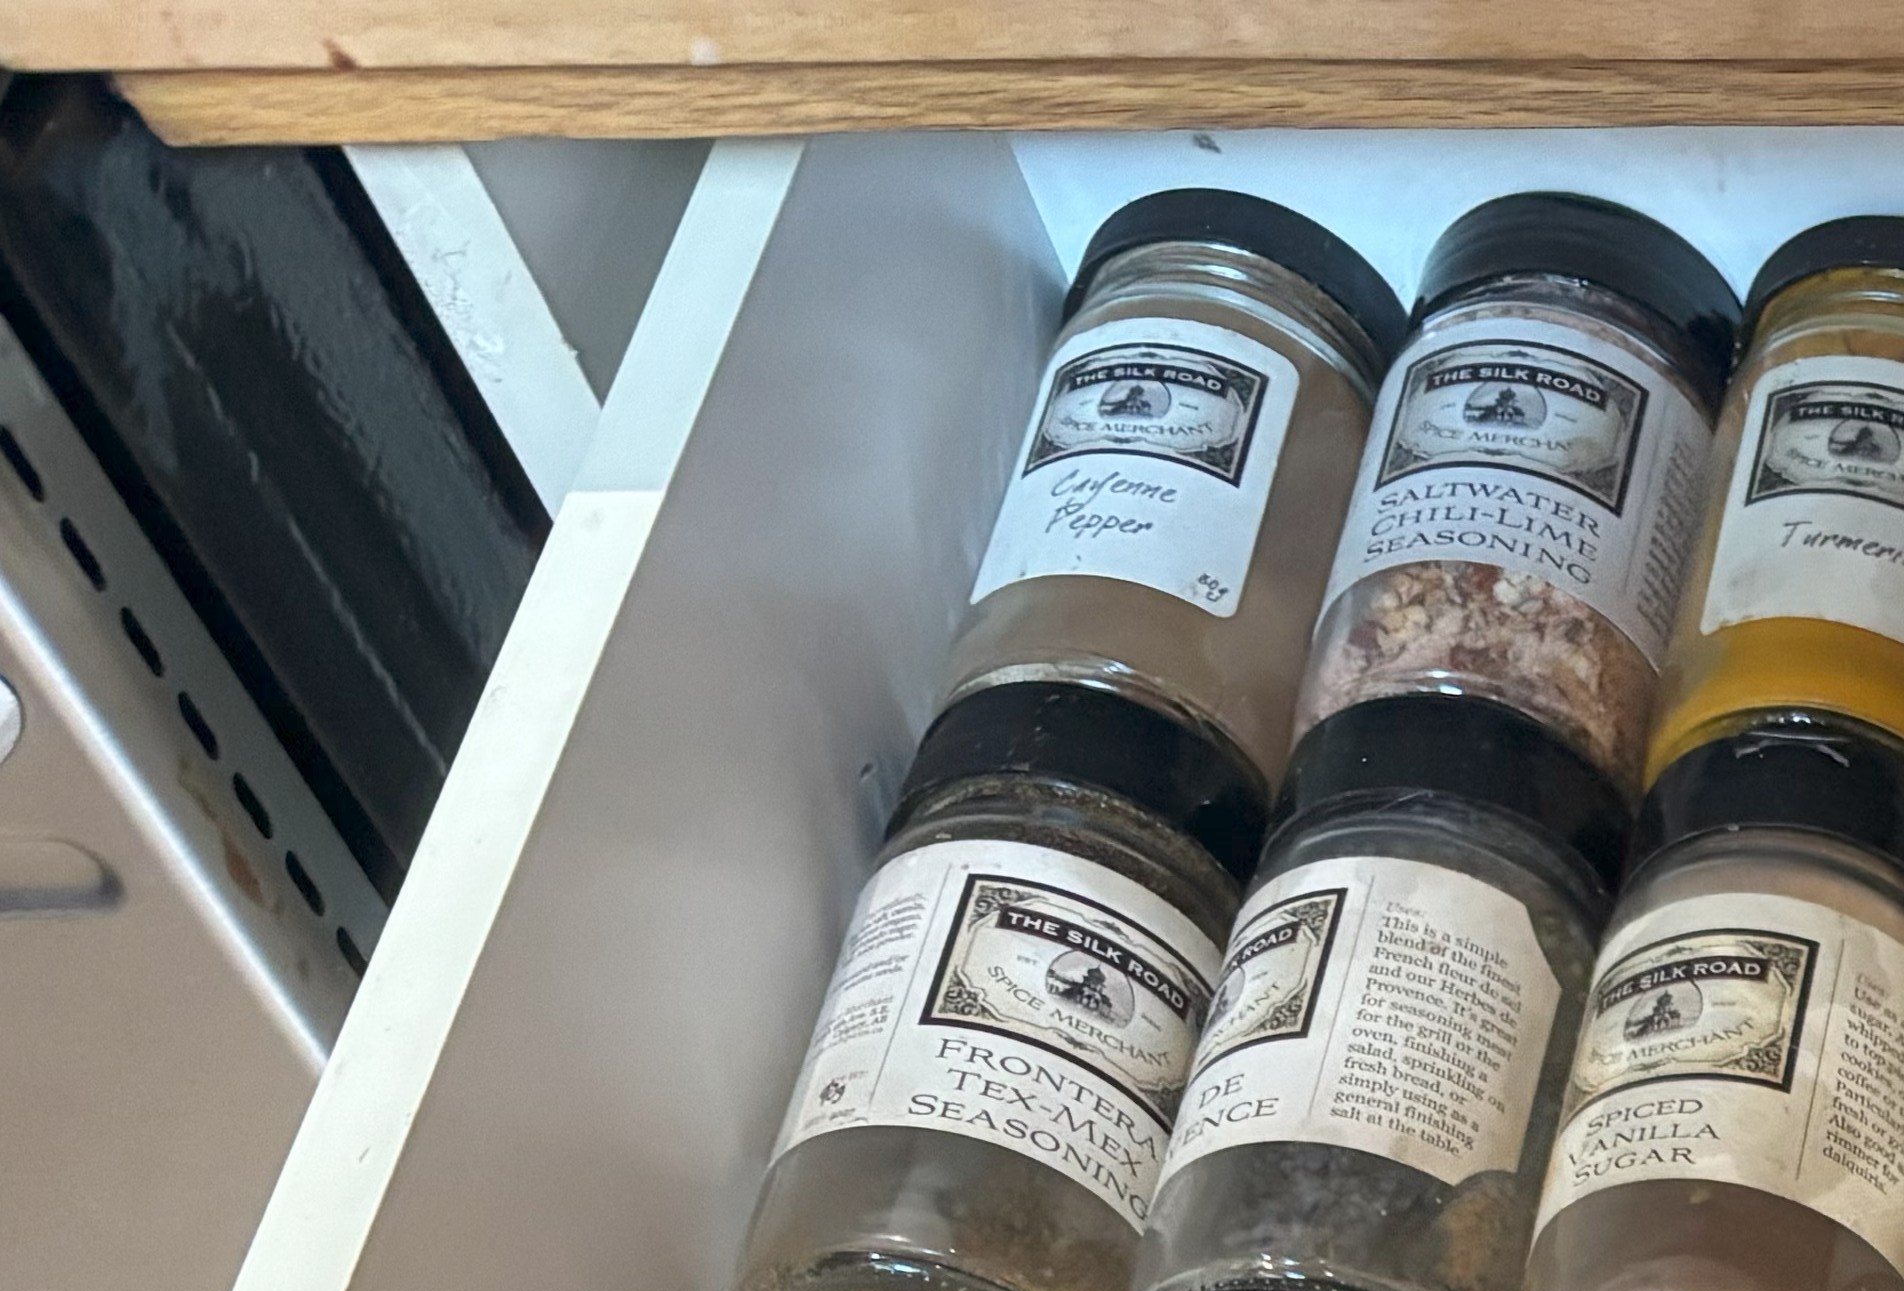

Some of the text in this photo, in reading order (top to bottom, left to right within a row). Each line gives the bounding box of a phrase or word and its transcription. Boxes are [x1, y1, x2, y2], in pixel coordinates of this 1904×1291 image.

[1045, 500, 1154, 538] Pepper
[1371, 505, 1598, 563] CHILI-LIME
[1377, 481, 1600, 537] SALTWATER
[1364, 529, 1592, 585] SEASONING
[1007, 911, 1185, 1010] THE SILK ROAD
[935, 1037, 1159, 1162] FRONTERA
[948, 1068, 1143, 1180] TEX-MEX
[1585, 1099, 1704, 1137] SPICED
[908, 1094, 1151, 1220] SEASONING
[1568, 1123, 1721, 1166] VANILLA
[1571, 1146, 1697, 1188] SUGAR
